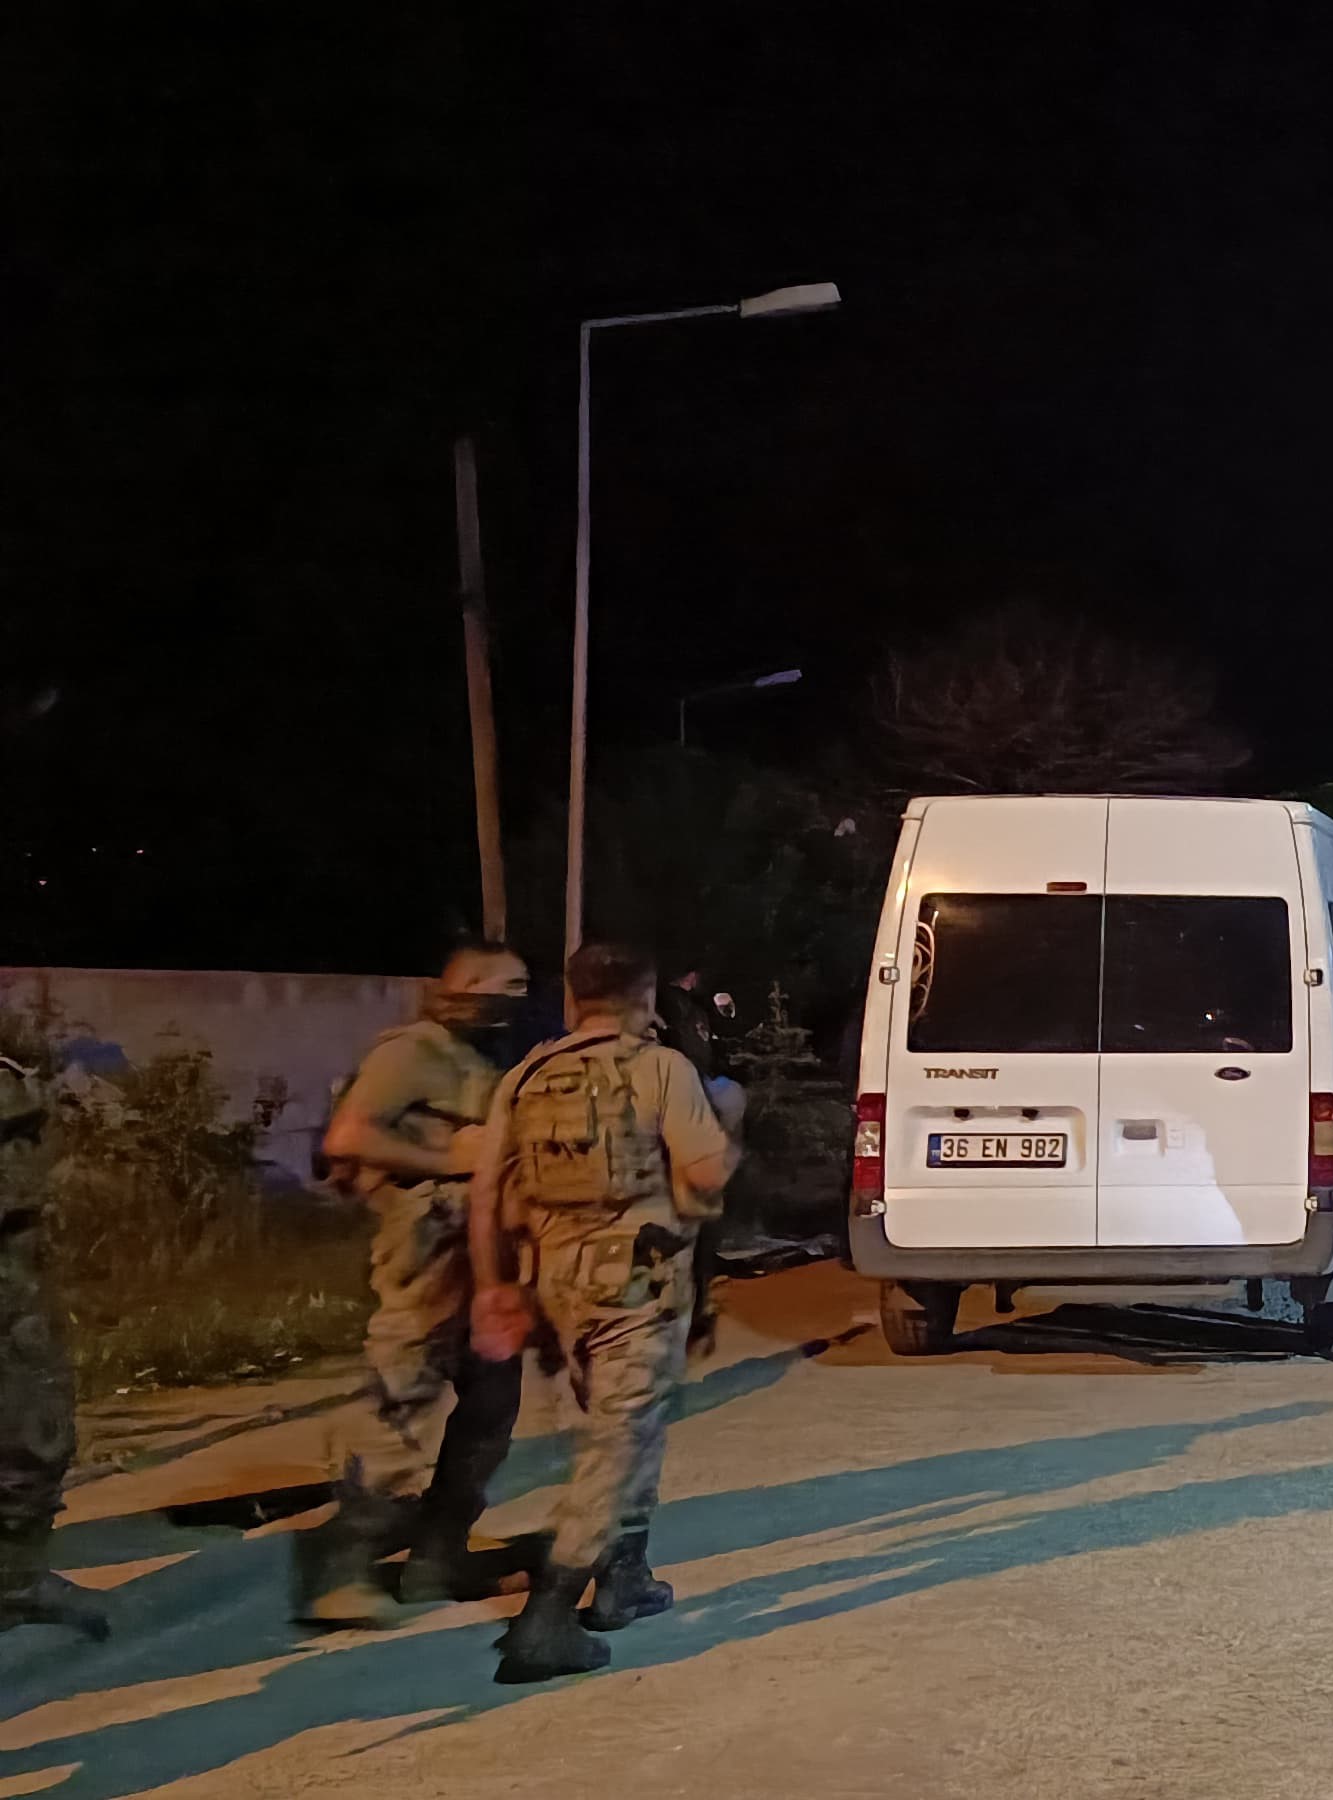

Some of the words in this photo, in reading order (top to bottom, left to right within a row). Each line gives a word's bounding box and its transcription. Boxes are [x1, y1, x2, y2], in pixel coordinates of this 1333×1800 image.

[923, 1067, 999, 1080] TRANSIT
[942, 1138, 969, 1159] 36
[981, 1138, 1008, 1158] EN
[1020, 1138, 1060, 1159] 982
